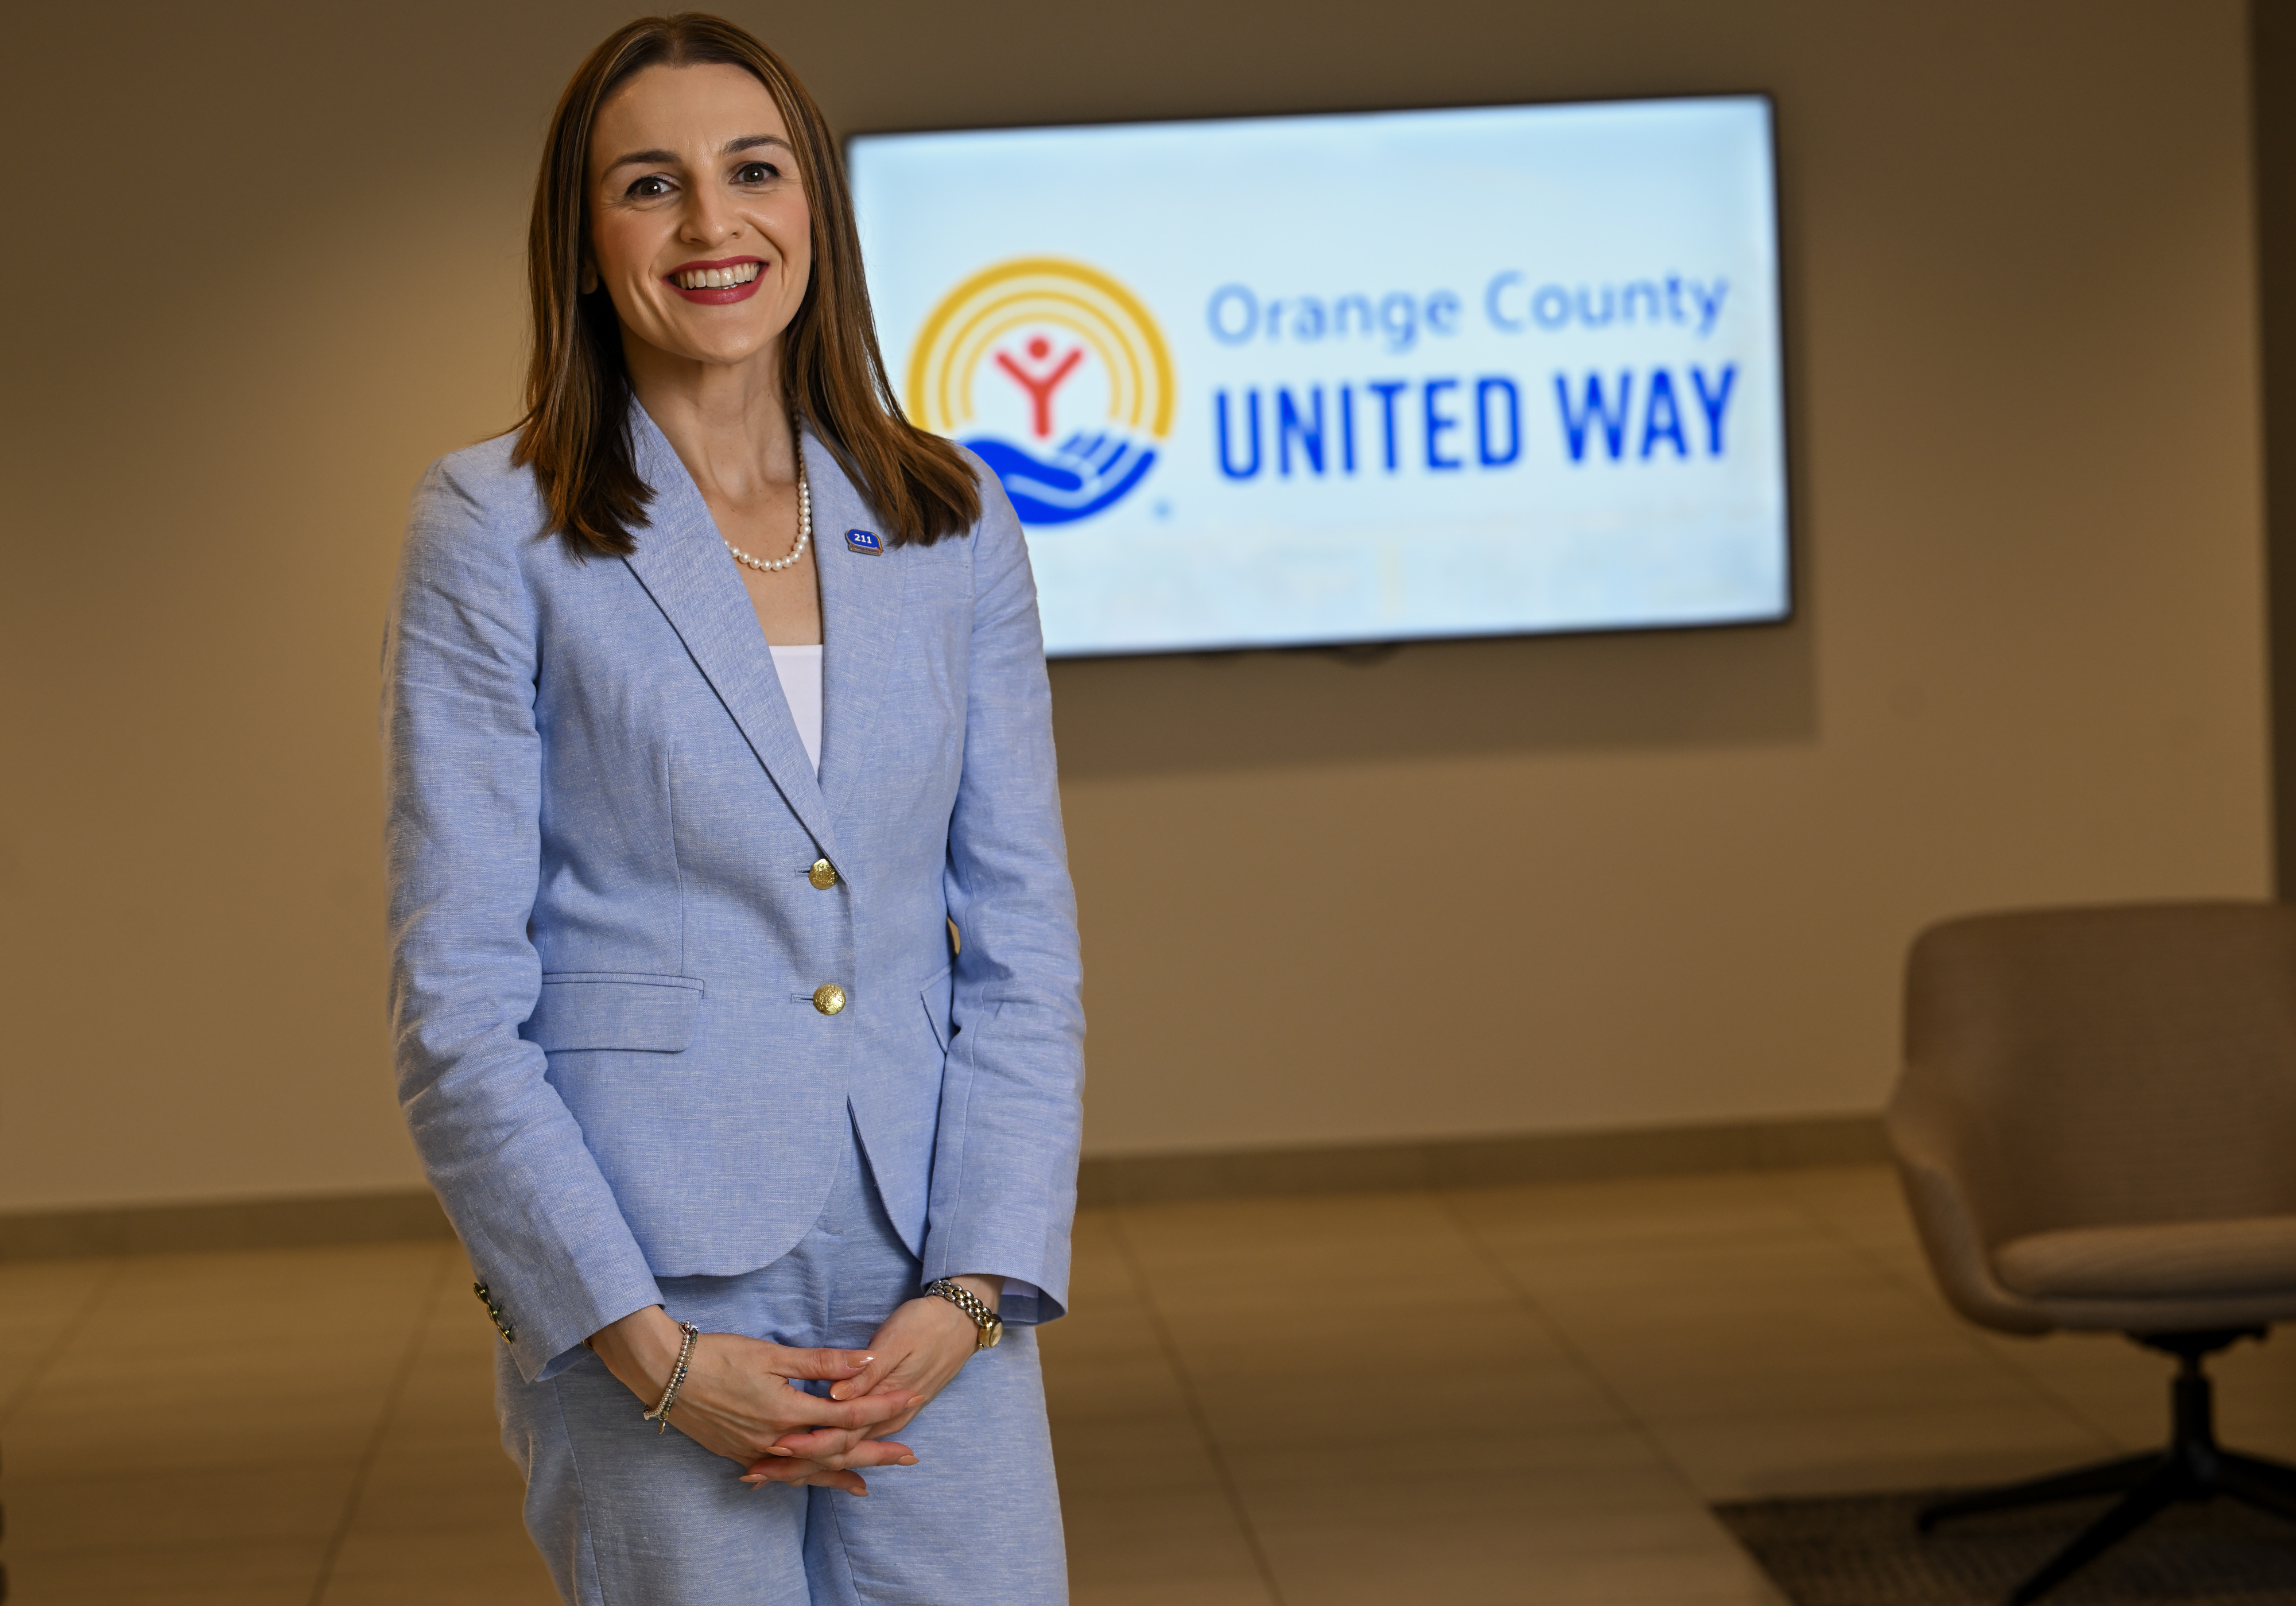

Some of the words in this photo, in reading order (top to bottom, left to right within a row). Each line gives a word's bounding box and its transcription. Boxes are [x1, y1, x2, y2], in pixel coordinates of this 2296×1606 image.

[1208, 284, 1461, 353] Orange
[1486, 270, 1730, 338] County
[1213, 374, 1524, 483] UNITED
[1553, 362, 1739, 465] WAY
[854, 533, 872, 544] 211
